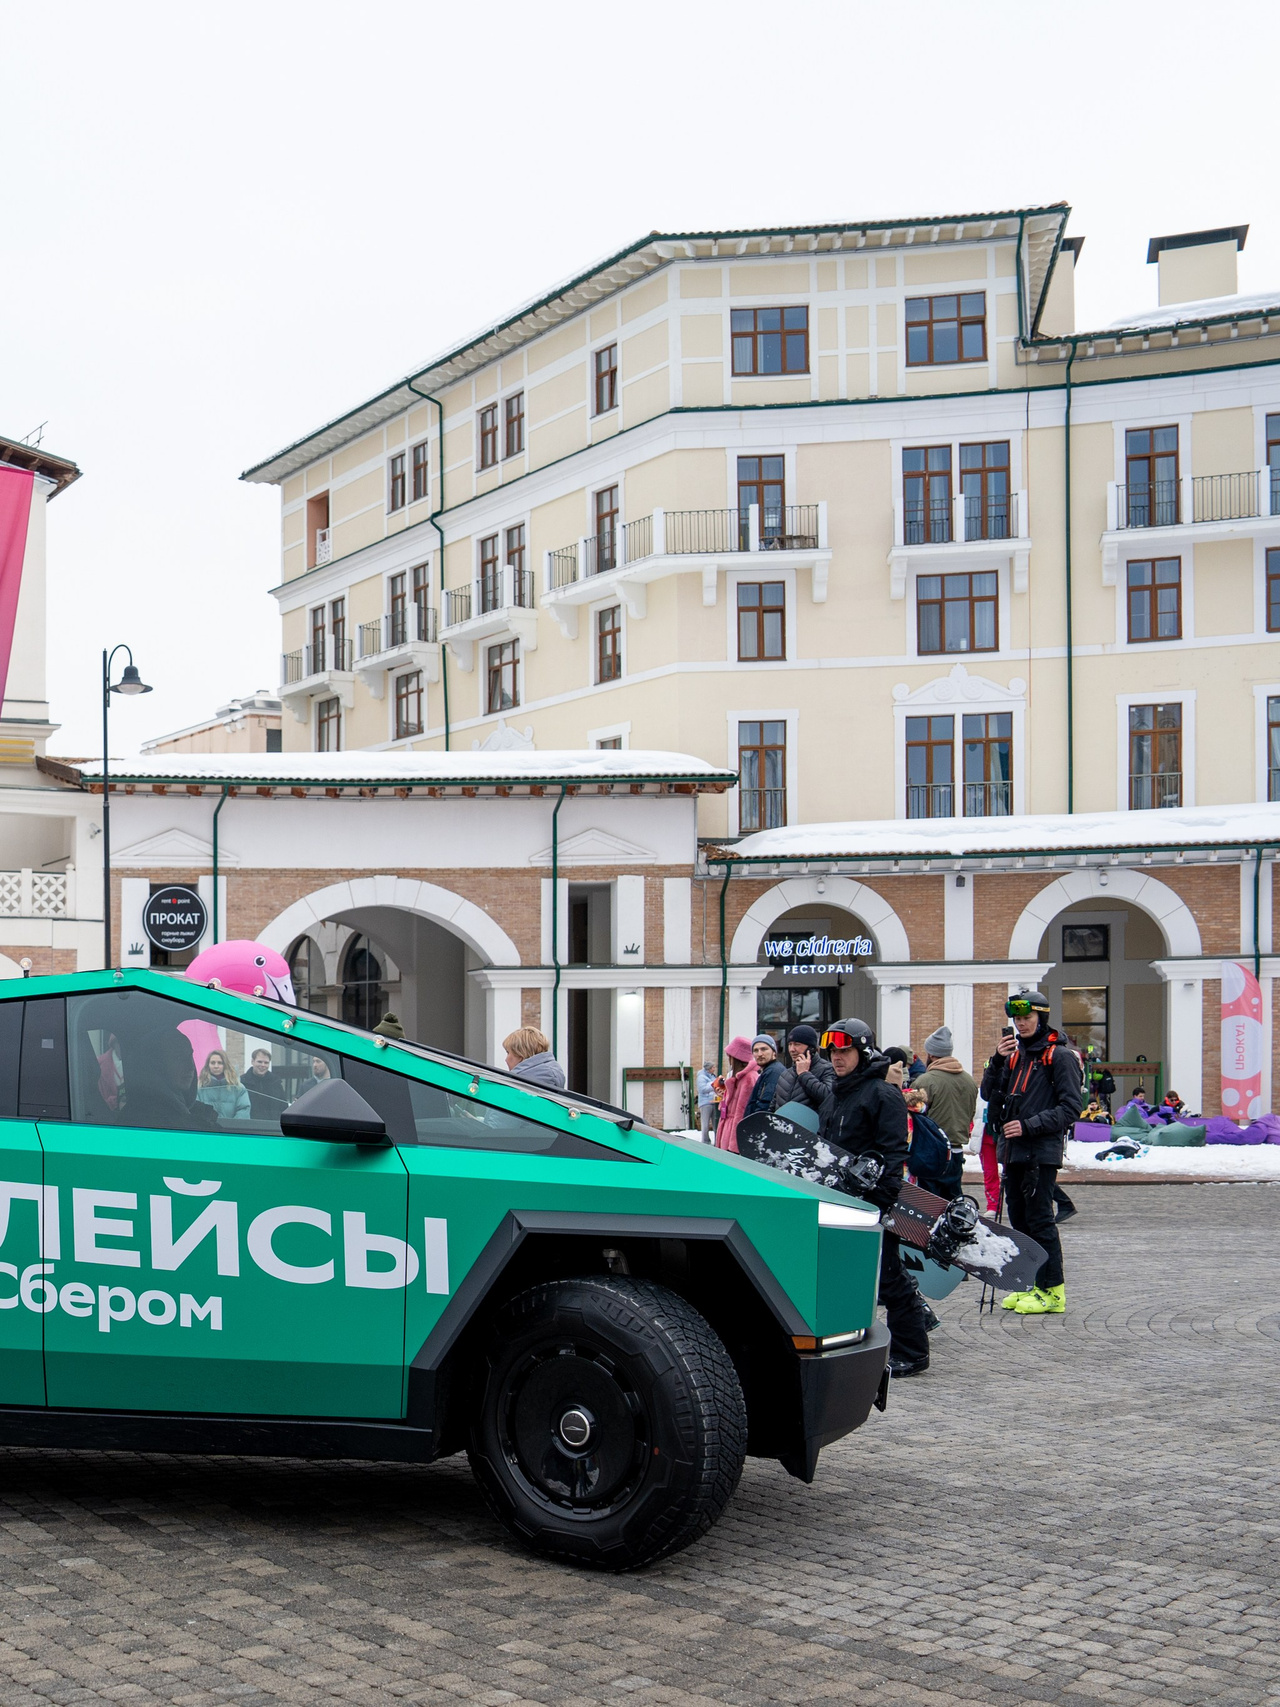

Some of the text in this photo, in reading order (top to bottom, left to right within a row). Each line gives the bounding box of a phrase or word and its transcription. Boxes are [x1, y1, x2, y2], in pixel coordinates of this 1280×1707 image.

[150, 912, 201, 925] ПРОКАТ
[763, 935, 873, 957] we cidreria
[782, 963, 854, 975] РЕСТОРАН
